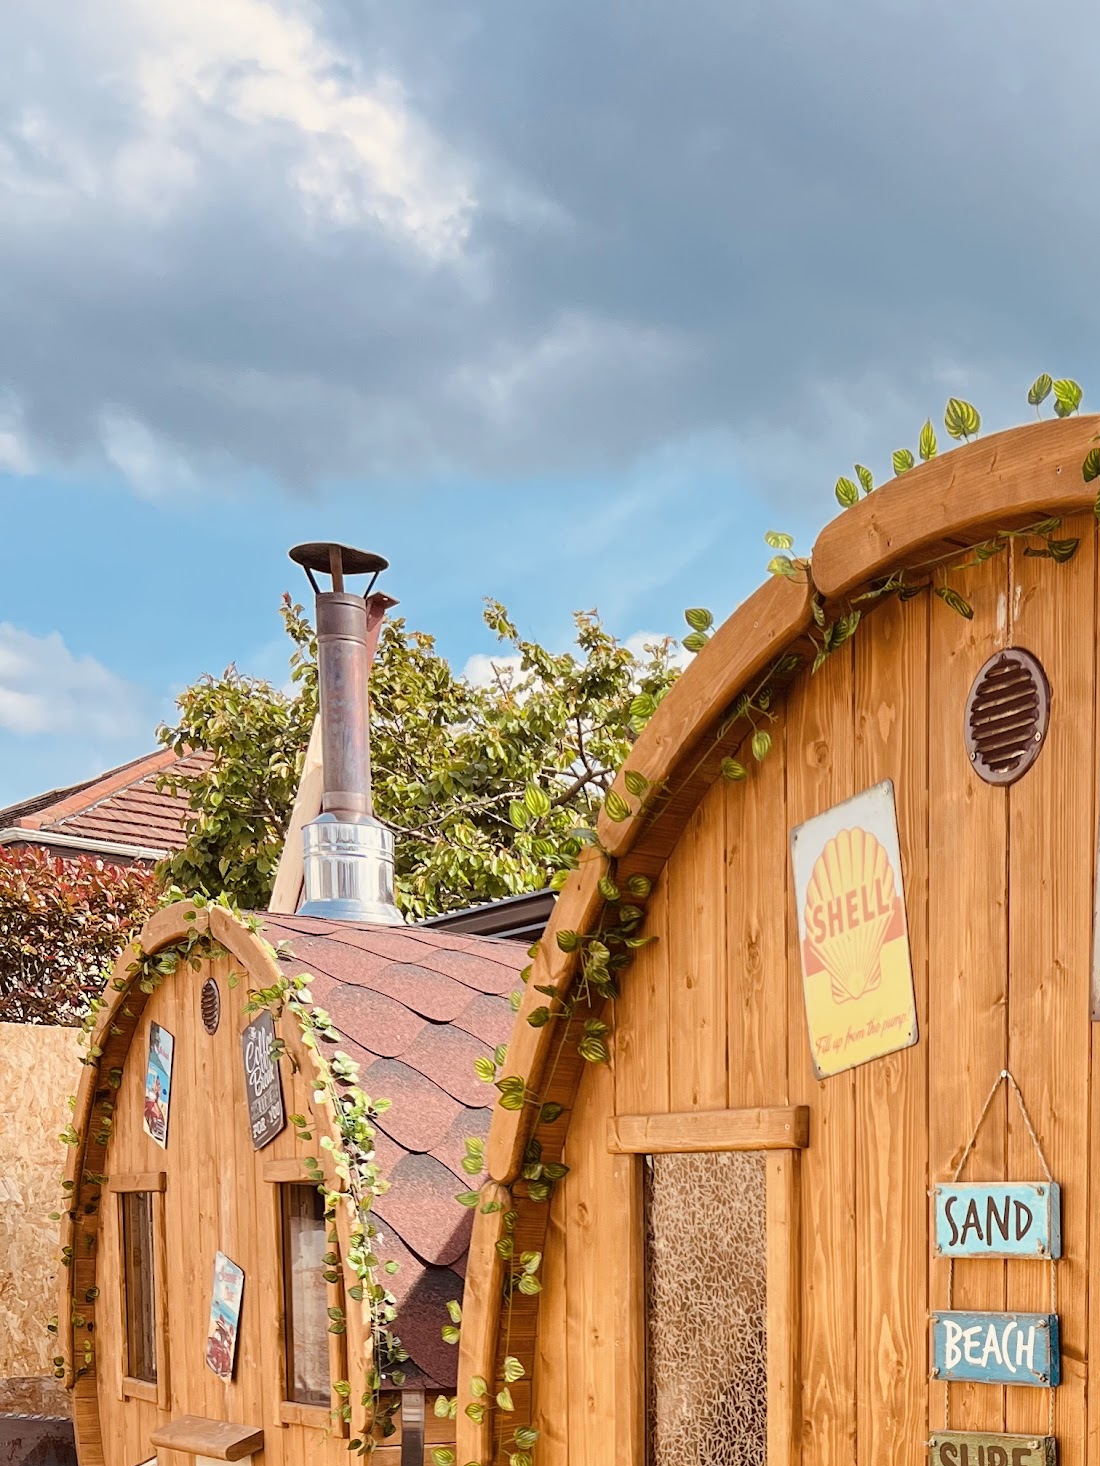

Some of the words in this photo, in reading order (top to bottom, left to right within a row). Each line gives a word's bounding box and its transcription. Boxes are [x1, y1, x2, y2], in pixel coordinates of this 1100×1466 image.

[812, 877, 891, 944] SHELL
[815, 1033, 832, 1056] Fill
[832, 1037, 843, 1054] up
[844, 1025, 865, 1052] from
[866, 1016, 880, 1036] the
[944, 1195, 1033, 1246] SAND
[942, 1320, 1036, 1373] BEACH
